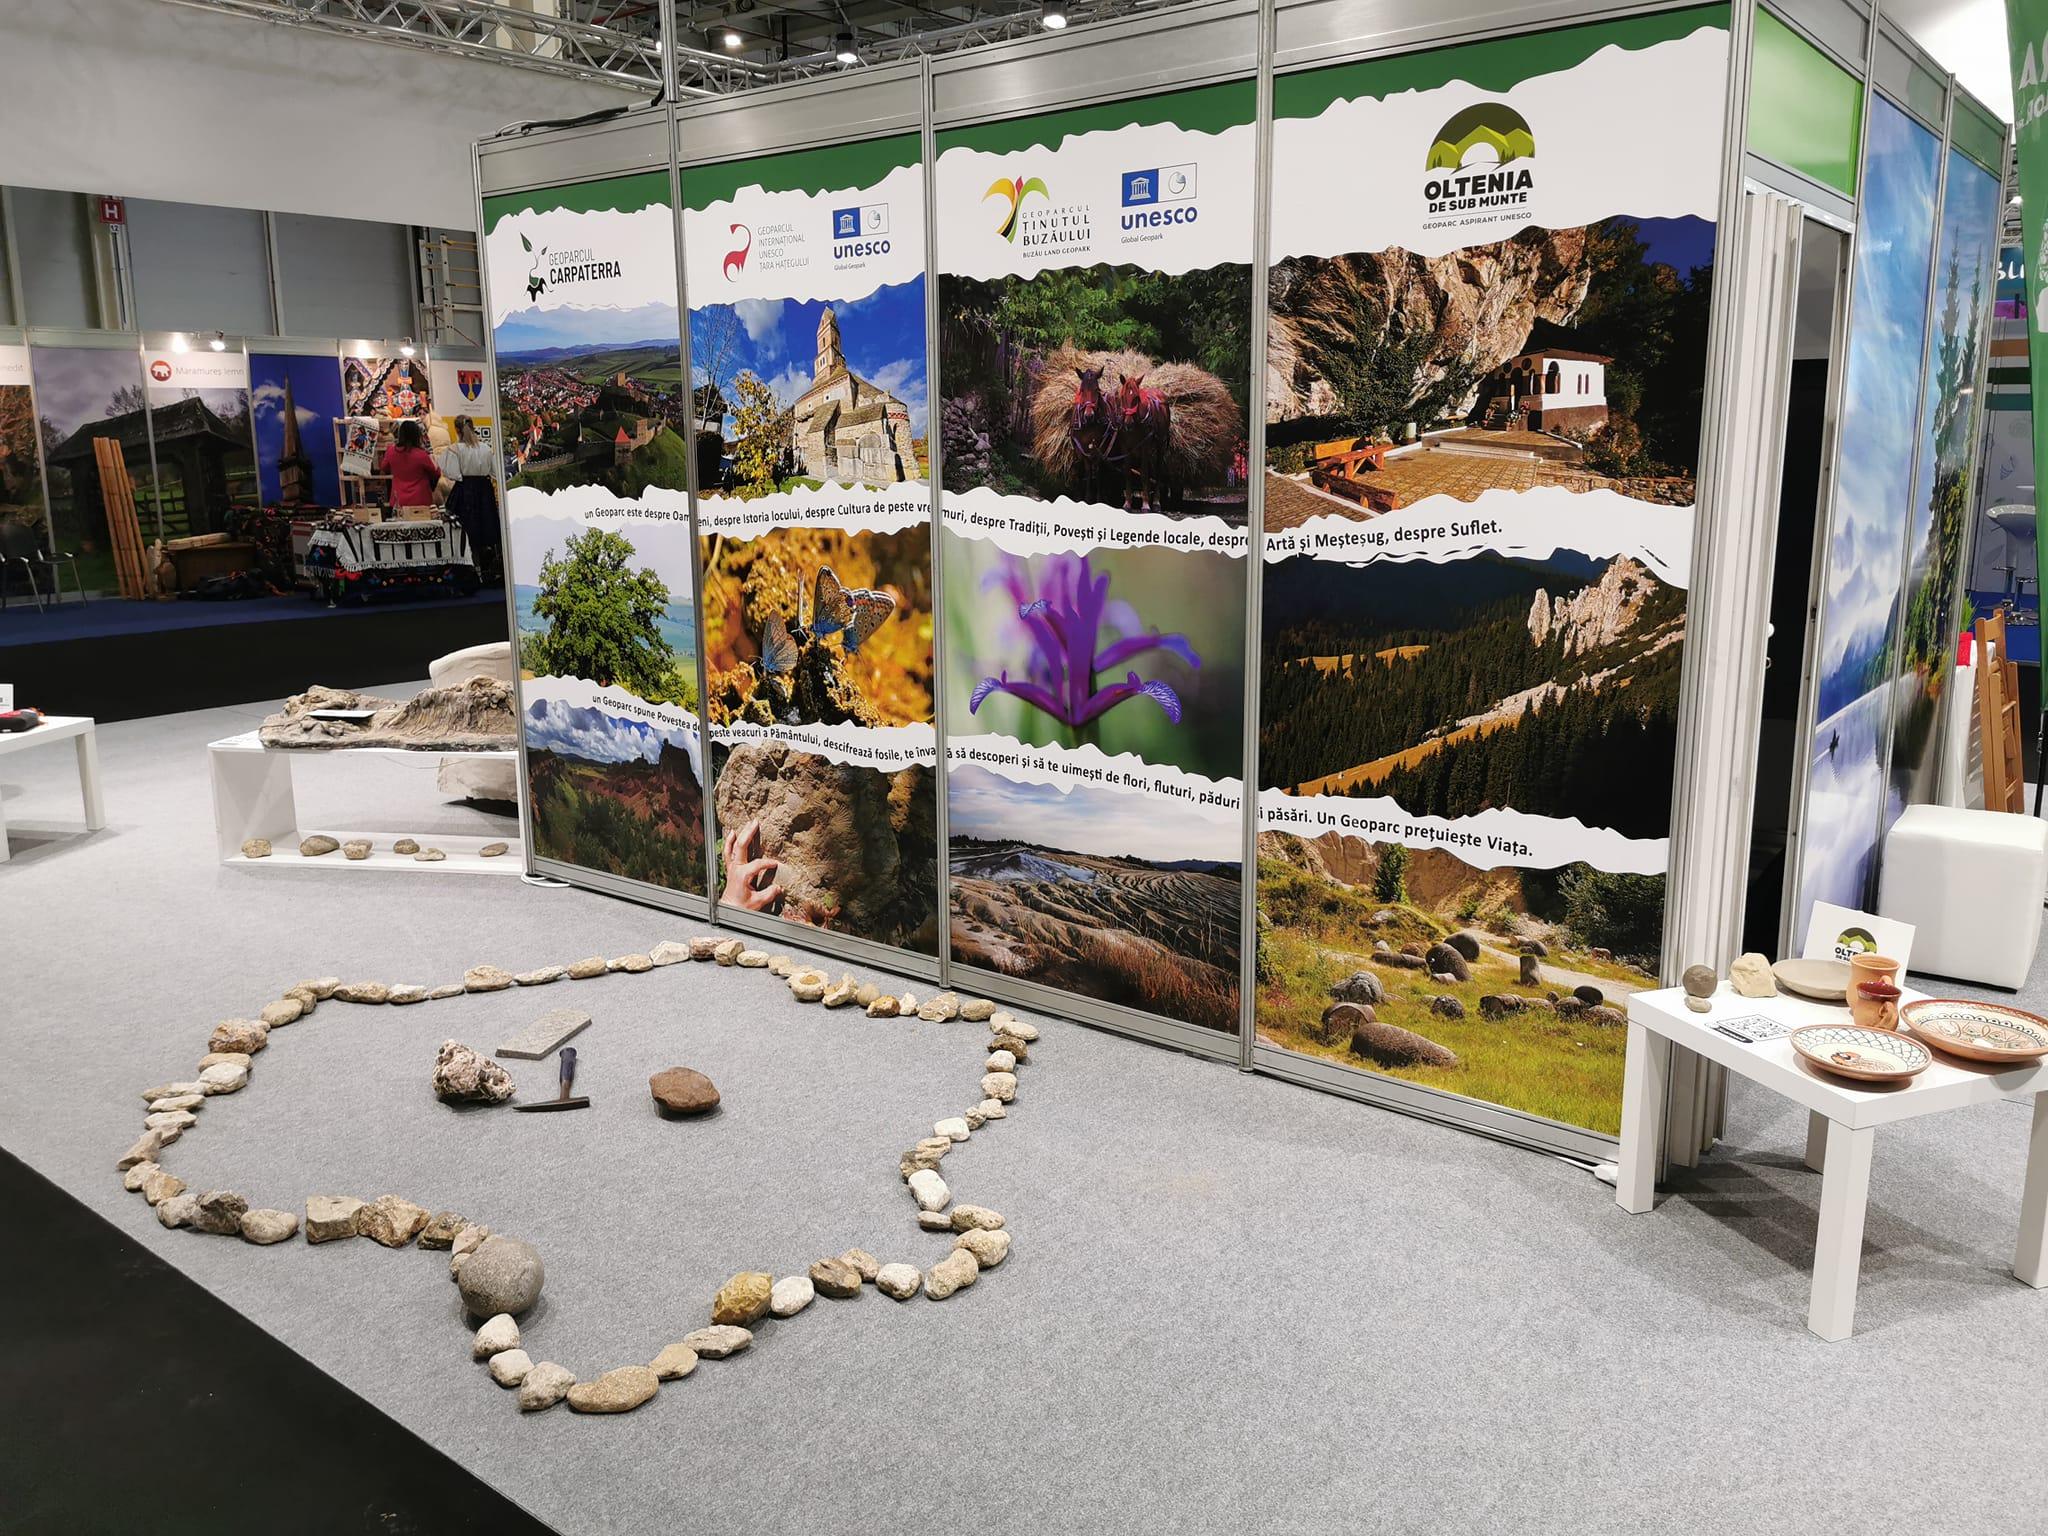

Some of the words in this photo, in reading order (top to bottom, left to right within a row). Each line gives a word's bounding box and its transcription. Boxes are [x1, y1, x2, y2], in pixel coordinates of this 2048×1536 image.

[1424, 169, 1533, 200] OLTENIA
[105, 203, 118, 219] H
[1022, 204, 1090, 219] GEOPARCUL
[1429, 202, 1446, 213] DE
[1449, 198, 1476, 211] SUB
[1480, 192, 1527, 207] MUNTE
[1023, 214, 1090, 234] ȚINUTUL
[1121, 206, 1197, 230] unesco
[1422, 220, 1457, 230] GEOPARC
[1460, 216, 1497, 226] ASPIRANT
[1500, 212, 1532, 221] UNESCO
[758, 223, 794, 236] GEOPARCUL
[1023, 229, 1091, 246] BUZĂULUI
[1121, 235, 1139, 244] Global
[1139, 233, 1163, 243] Geopark
[549, 248, 595, 266] GEOPARCUL
[759, 248, 783, 260] UNESCO
[834, 240, 890, 259] unesco
[1062, 246, 1091, 254] GEOPARK
[550, 261, 622, 285] CARPATERRA
[584, 510, 594, 520] un
[595, 508, 625, 521] Geoparc
[627, 509, 643, 518] este
[644, 508, 670, 523] despre
[714, 514, 741, 527] despre
[743, 512, 769, 524] Istoria
[772, 507, 803, 522] locului,
[805, 506, 835, 520] despre
[837, 502, 871, 516] Cultura
[874, 501, 885, 513] de
[888, 500, 914, 515] peste
[970, 512, 1005, 529] despre
[1110, 528, 1159, 545] Legende
[1164, 530, 1204, 547] locale,
[1266, 535, 1295, 552] Artă
[1394, 525, 1446, 544] despre
[1451, 519, 1503, 537] Suflet.
[592, 695, 602, 705] un
[602, 697, 632, 713] Geoparc
[634, 706, 656, 720] spune
[657, 711, 691, 730] Povestea
[709, 727, 731, 740] peste
[733, 727, 761, 738] veacuri
[763, 730, 768, 738] a
[770, 728, 821, 747] Pământului,
[823, 736, 873, 759] descifrează
[875, 749, 903, 762] fosile,
[904, 749, 915, 759] te
[955, 747, 966, 760] să
[969, 748, 1019, 765] descoperi
[1033, 757, 1044, 770] să
[1048, 760, 1059, 772] te
[1105, 770, 1120, 784] de
[1123, 773, 1151, 792] flori,
[1154, 780, 1195, 802] fluturi,
[1199, 790, 1240, 810] păduri
[1267, 806, 1313, 824] păsări.
[1317, 811, 1336, 825] Un
[1341, 813, 1400, 835] Geoparc
